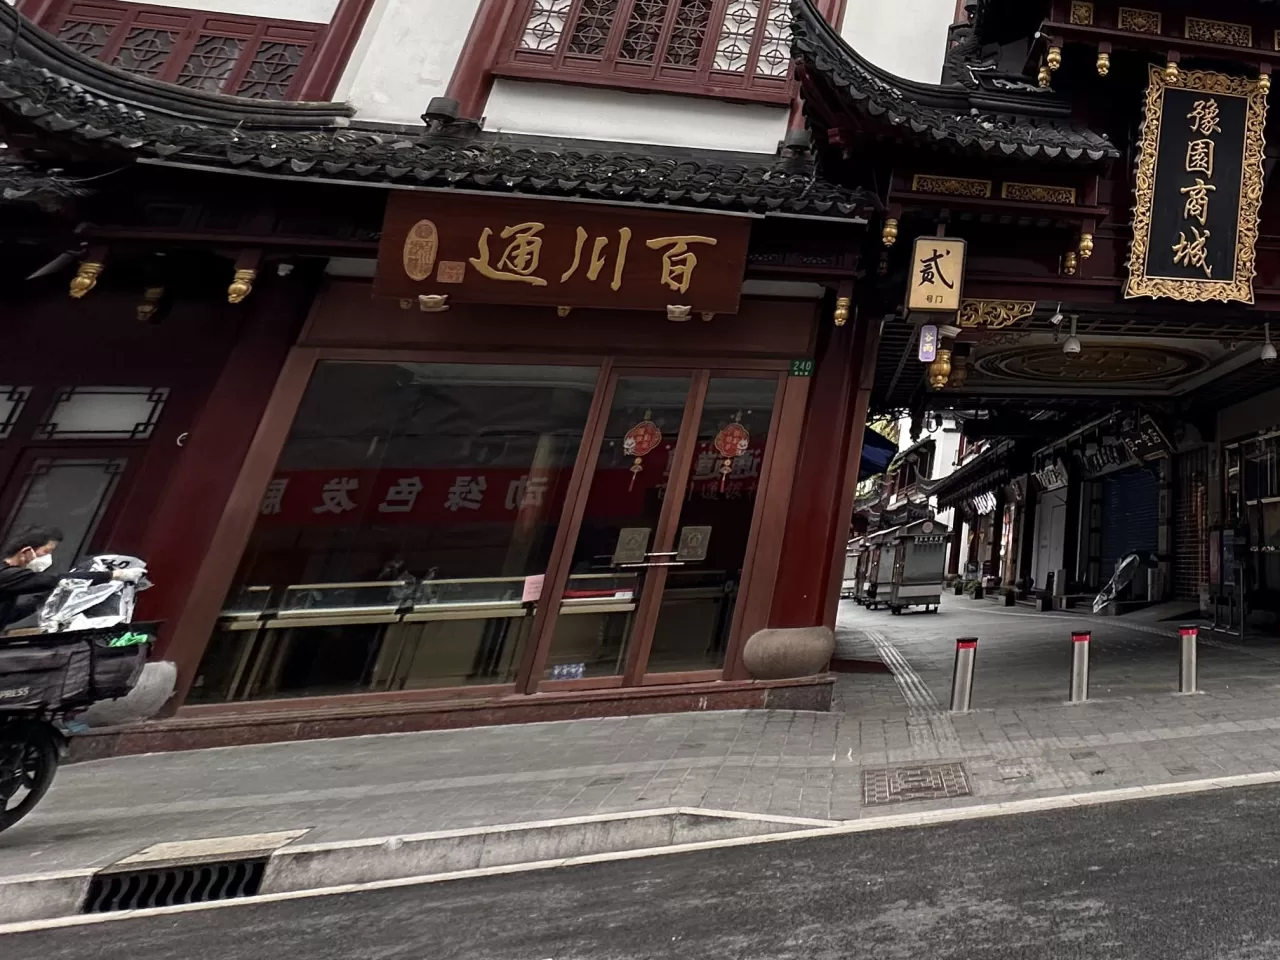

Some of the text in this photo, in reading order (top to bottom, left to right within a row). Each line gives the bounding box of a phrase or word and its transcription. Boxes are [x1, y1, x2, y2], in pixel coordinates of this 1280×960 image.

[468, 222, 718, 294] 百川通
[926, 295, 944, 304] 号门
[923, 332, 934, 353] 谷雨
[793, 361, 812, 370] 240
